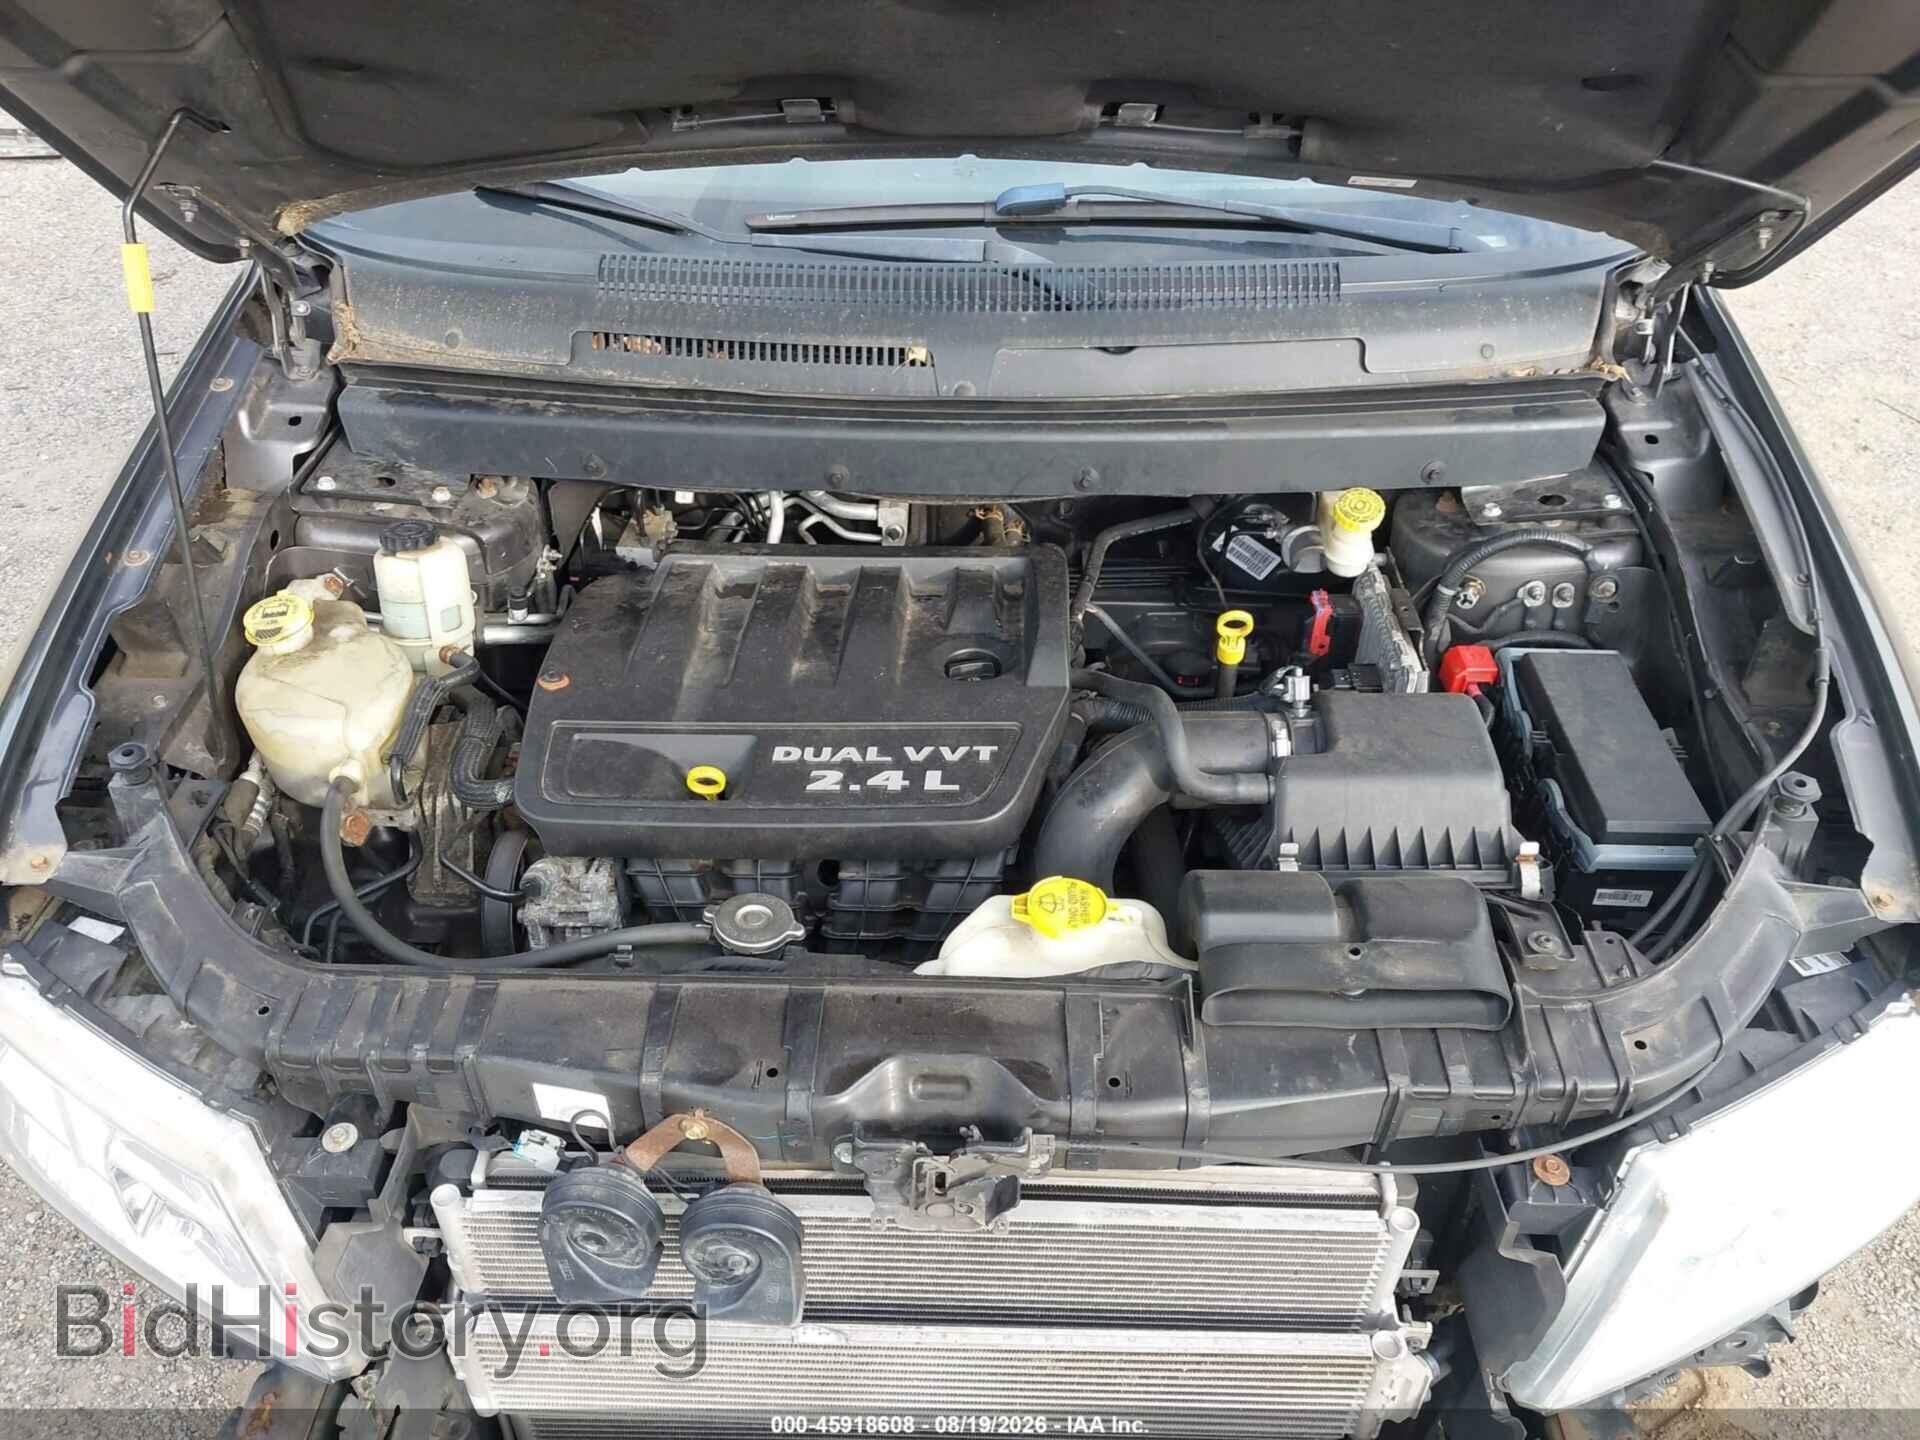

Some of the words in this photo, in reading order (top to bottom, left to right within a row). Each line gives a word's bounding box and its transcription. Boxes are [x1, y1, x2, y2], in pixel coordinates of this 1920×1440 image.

[772, 746, 893, 762] DUAL
[903, 745, 999, 761] VVT
[805, 770, 910, 791] 2.4
[923, 770, 960, 791] L
